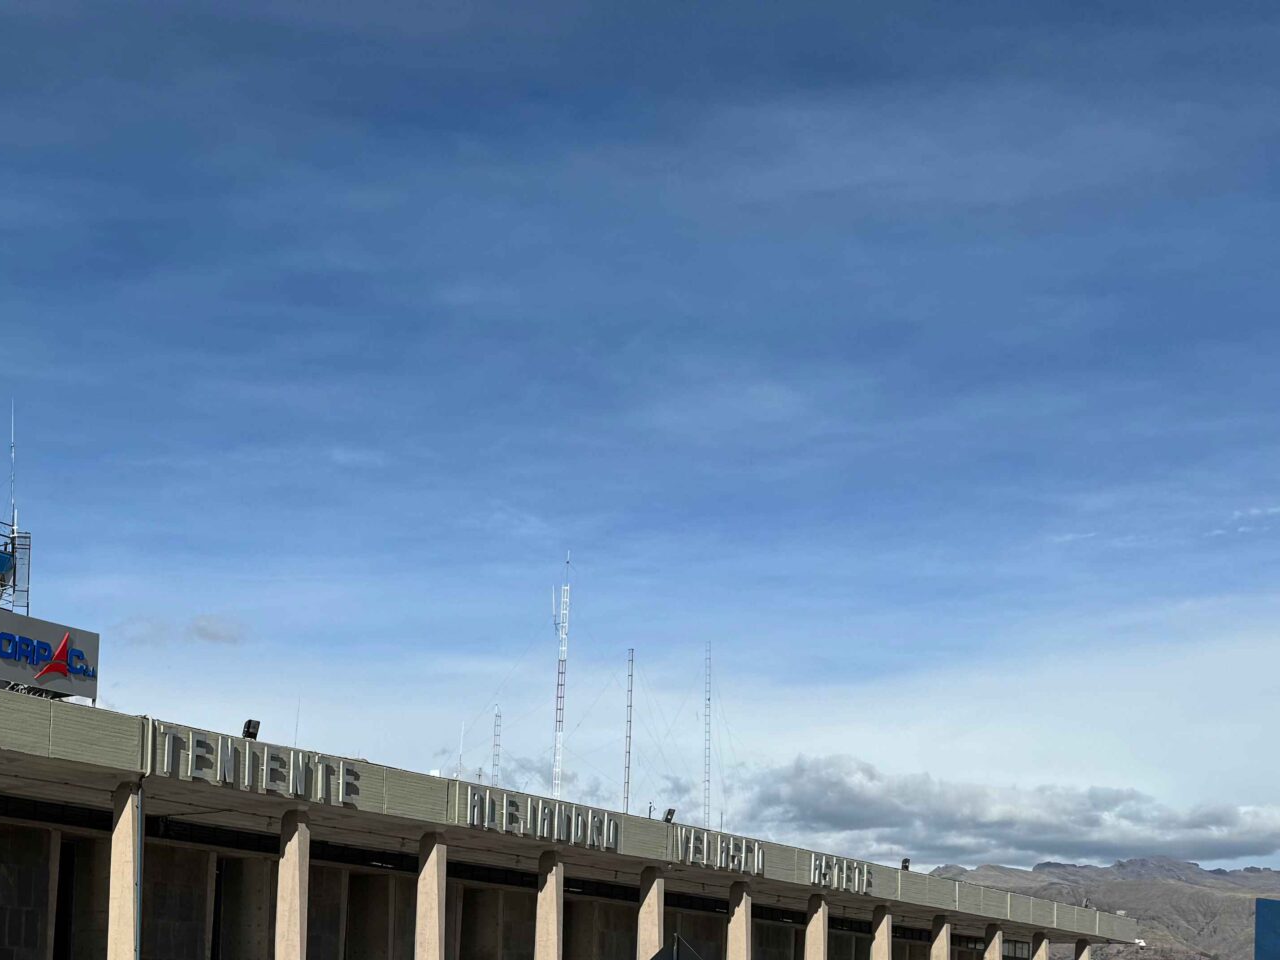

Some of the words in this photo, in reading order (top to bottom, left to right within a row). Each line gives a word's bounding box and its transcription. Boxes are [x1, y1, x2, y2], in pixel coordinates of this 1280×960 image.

[160, 724, 357, 804] TENIENTE
[467, 785, 617, 849] ALEJANDRO
[677, 825, 764, 876] VELASCO
[811, 852, 869, 894] ASTETE
